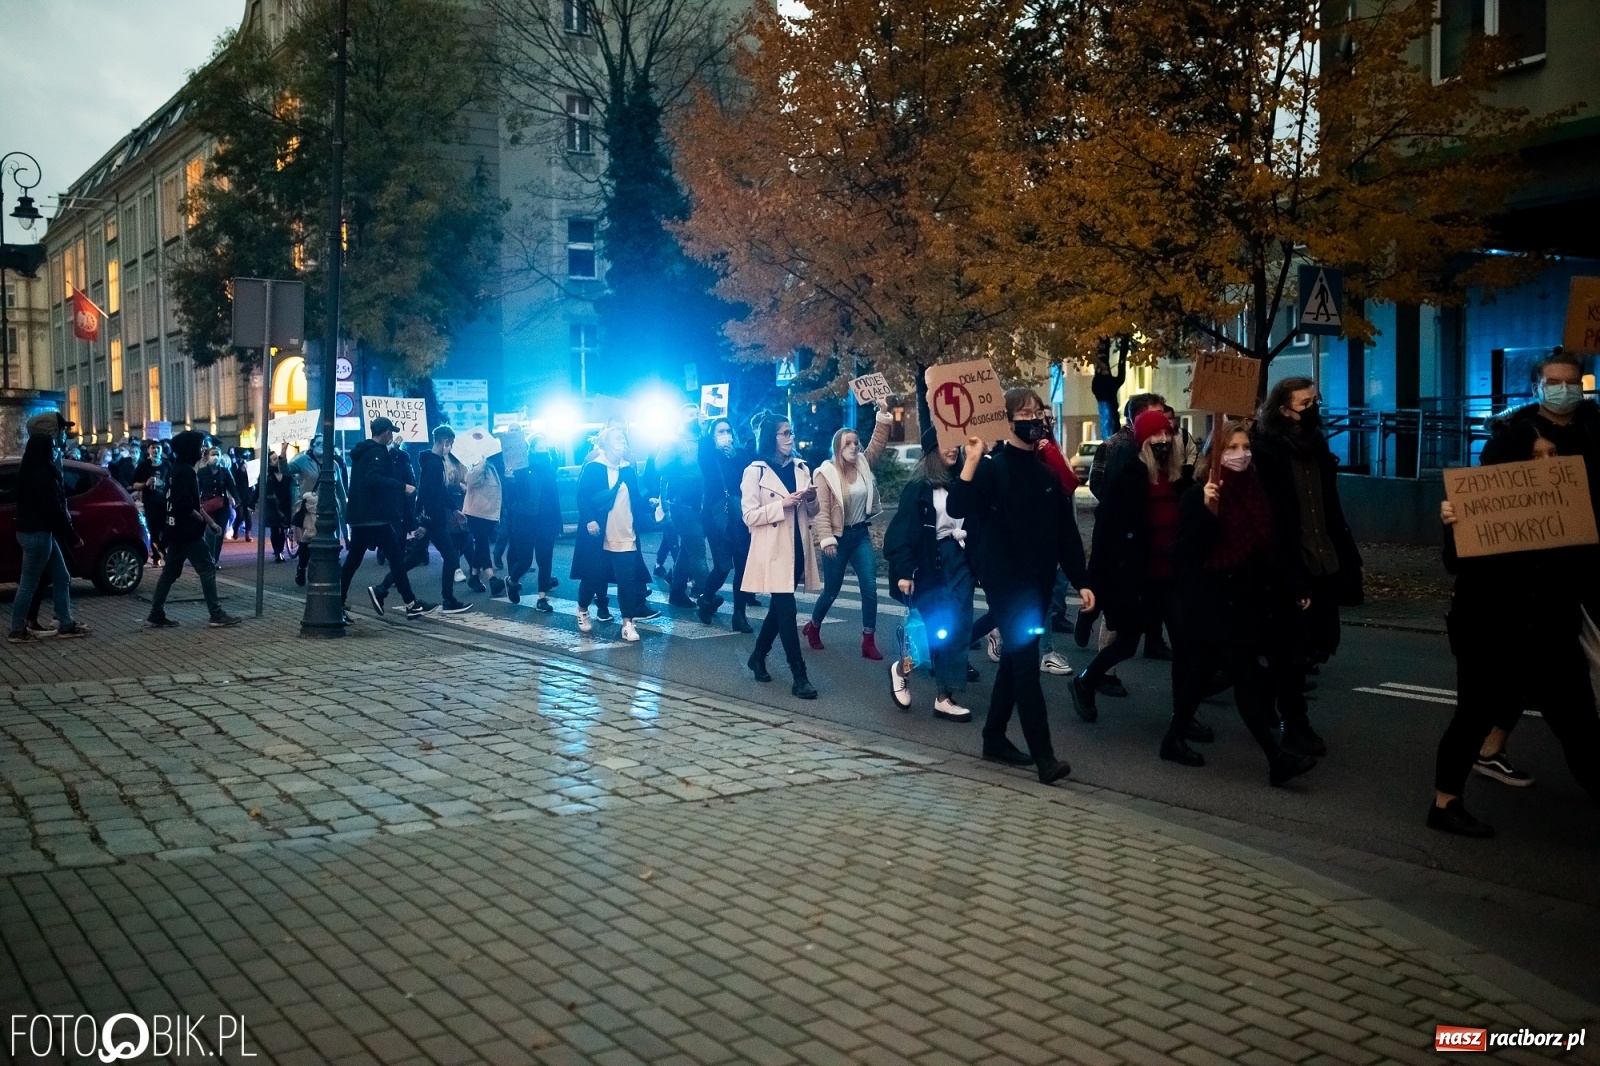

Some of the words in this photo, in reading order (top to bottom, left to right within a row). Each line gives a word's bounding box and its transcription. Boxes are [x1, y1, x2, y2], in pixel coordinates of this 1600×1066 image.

[1203, 353, 1256, 378] PIEKŁO
[855, 376, 883, 390] MOJE
[959, 369, 994, 386] DOŁĄCZ
[860, 385, 891, 401] CIAŁO
[978, 392, 992, 404] DO
[365, 399, 389, 408] ŁAPY
[395, 400, 425, 411] PRECZ
[368, 409, 381, 418] OD
[387, 410, 418, 421] MOJEJ
[1454, 467, 1539, 494] ZAJMIJCIE
[1548, 461, 1578, 487] SIĘ
[1463, 486, 1570, 518] NARODZONYMI,
[1475, 511, 1566, 547] HIPOKRYCI
